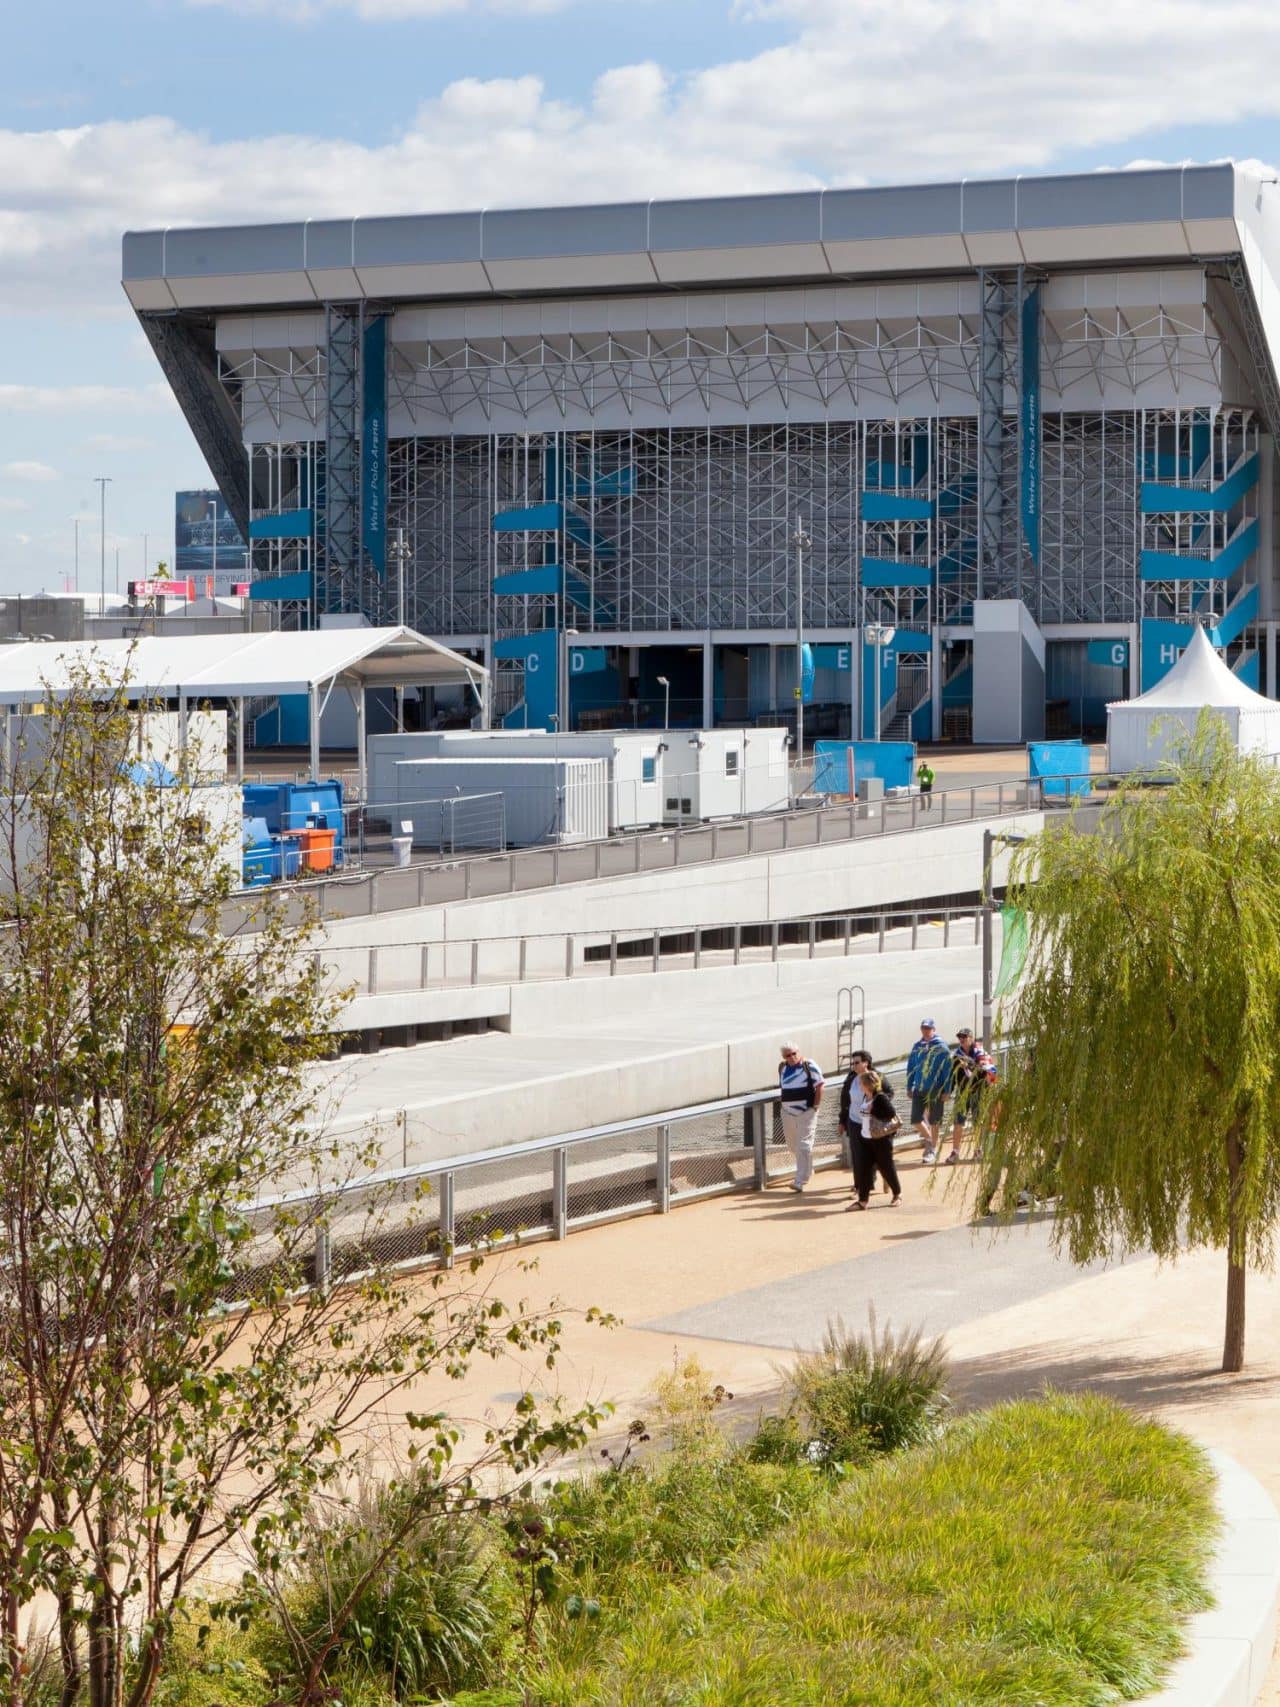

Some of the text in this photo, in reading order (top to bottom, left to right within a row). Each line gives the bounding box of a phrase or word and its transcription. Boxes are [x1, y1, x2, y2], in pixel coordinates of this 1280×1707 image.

[1028, 394, 1036, 514] Water Polo Arena
[369, 419, 379, 531] Water Polo Arena
[527, 653, 539, 672] C
[572, 653, 584, 672] D
[838, 649, 848, 669] E
[883, 649, 894, 669] F
[1111, 644, 1125, 664] G
[1160, 643, 1174, 664] H
